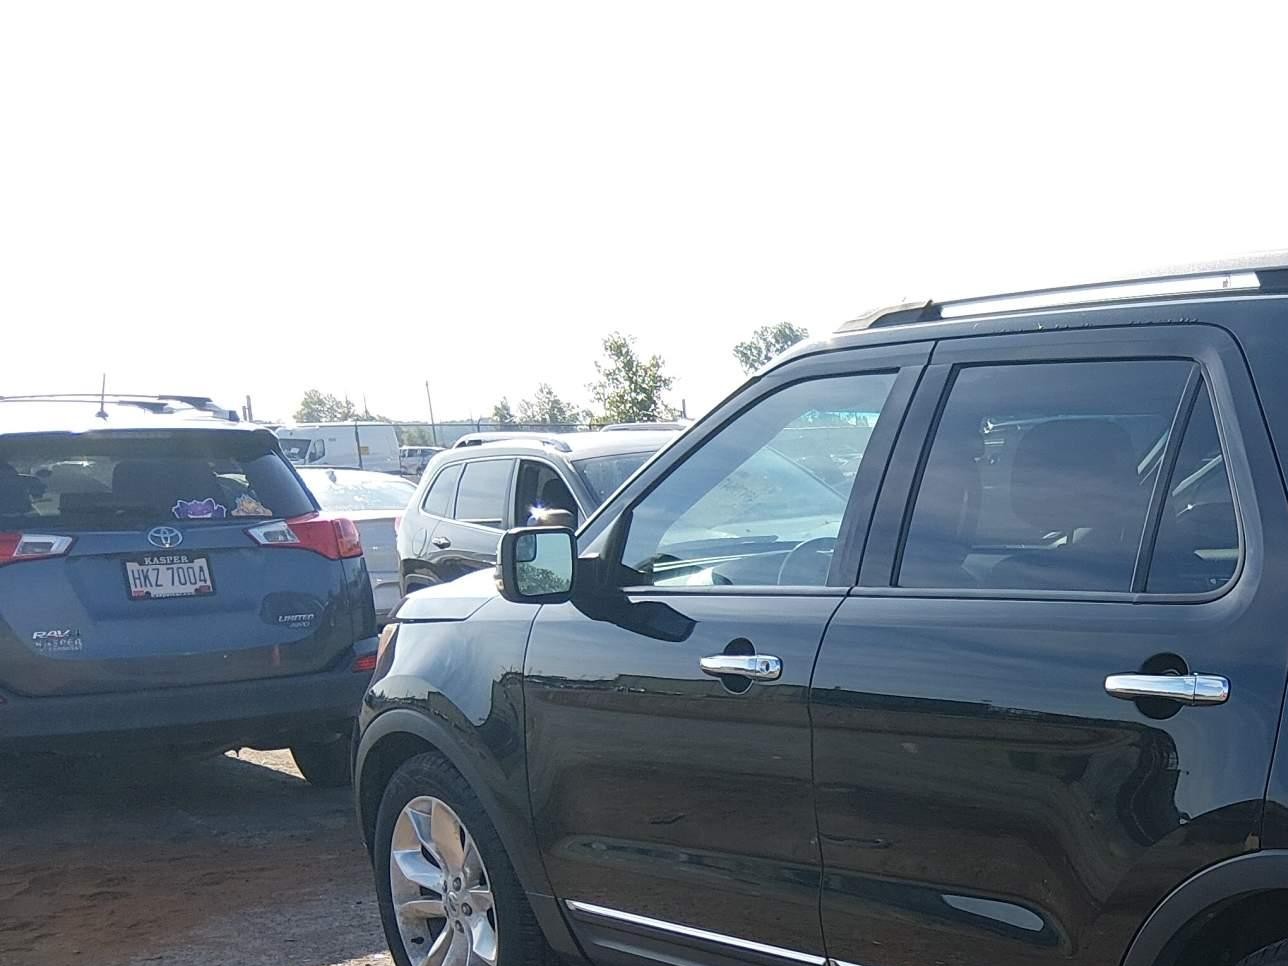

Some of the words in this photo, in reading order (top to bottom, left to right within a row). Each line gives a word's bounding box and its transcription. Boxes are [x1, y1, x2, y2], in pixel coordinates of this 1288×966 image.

[143, 555, 189, 565] KASPER
[131, 566, 164, 589] HKZ
[166, 564, 207, 587] 7004
